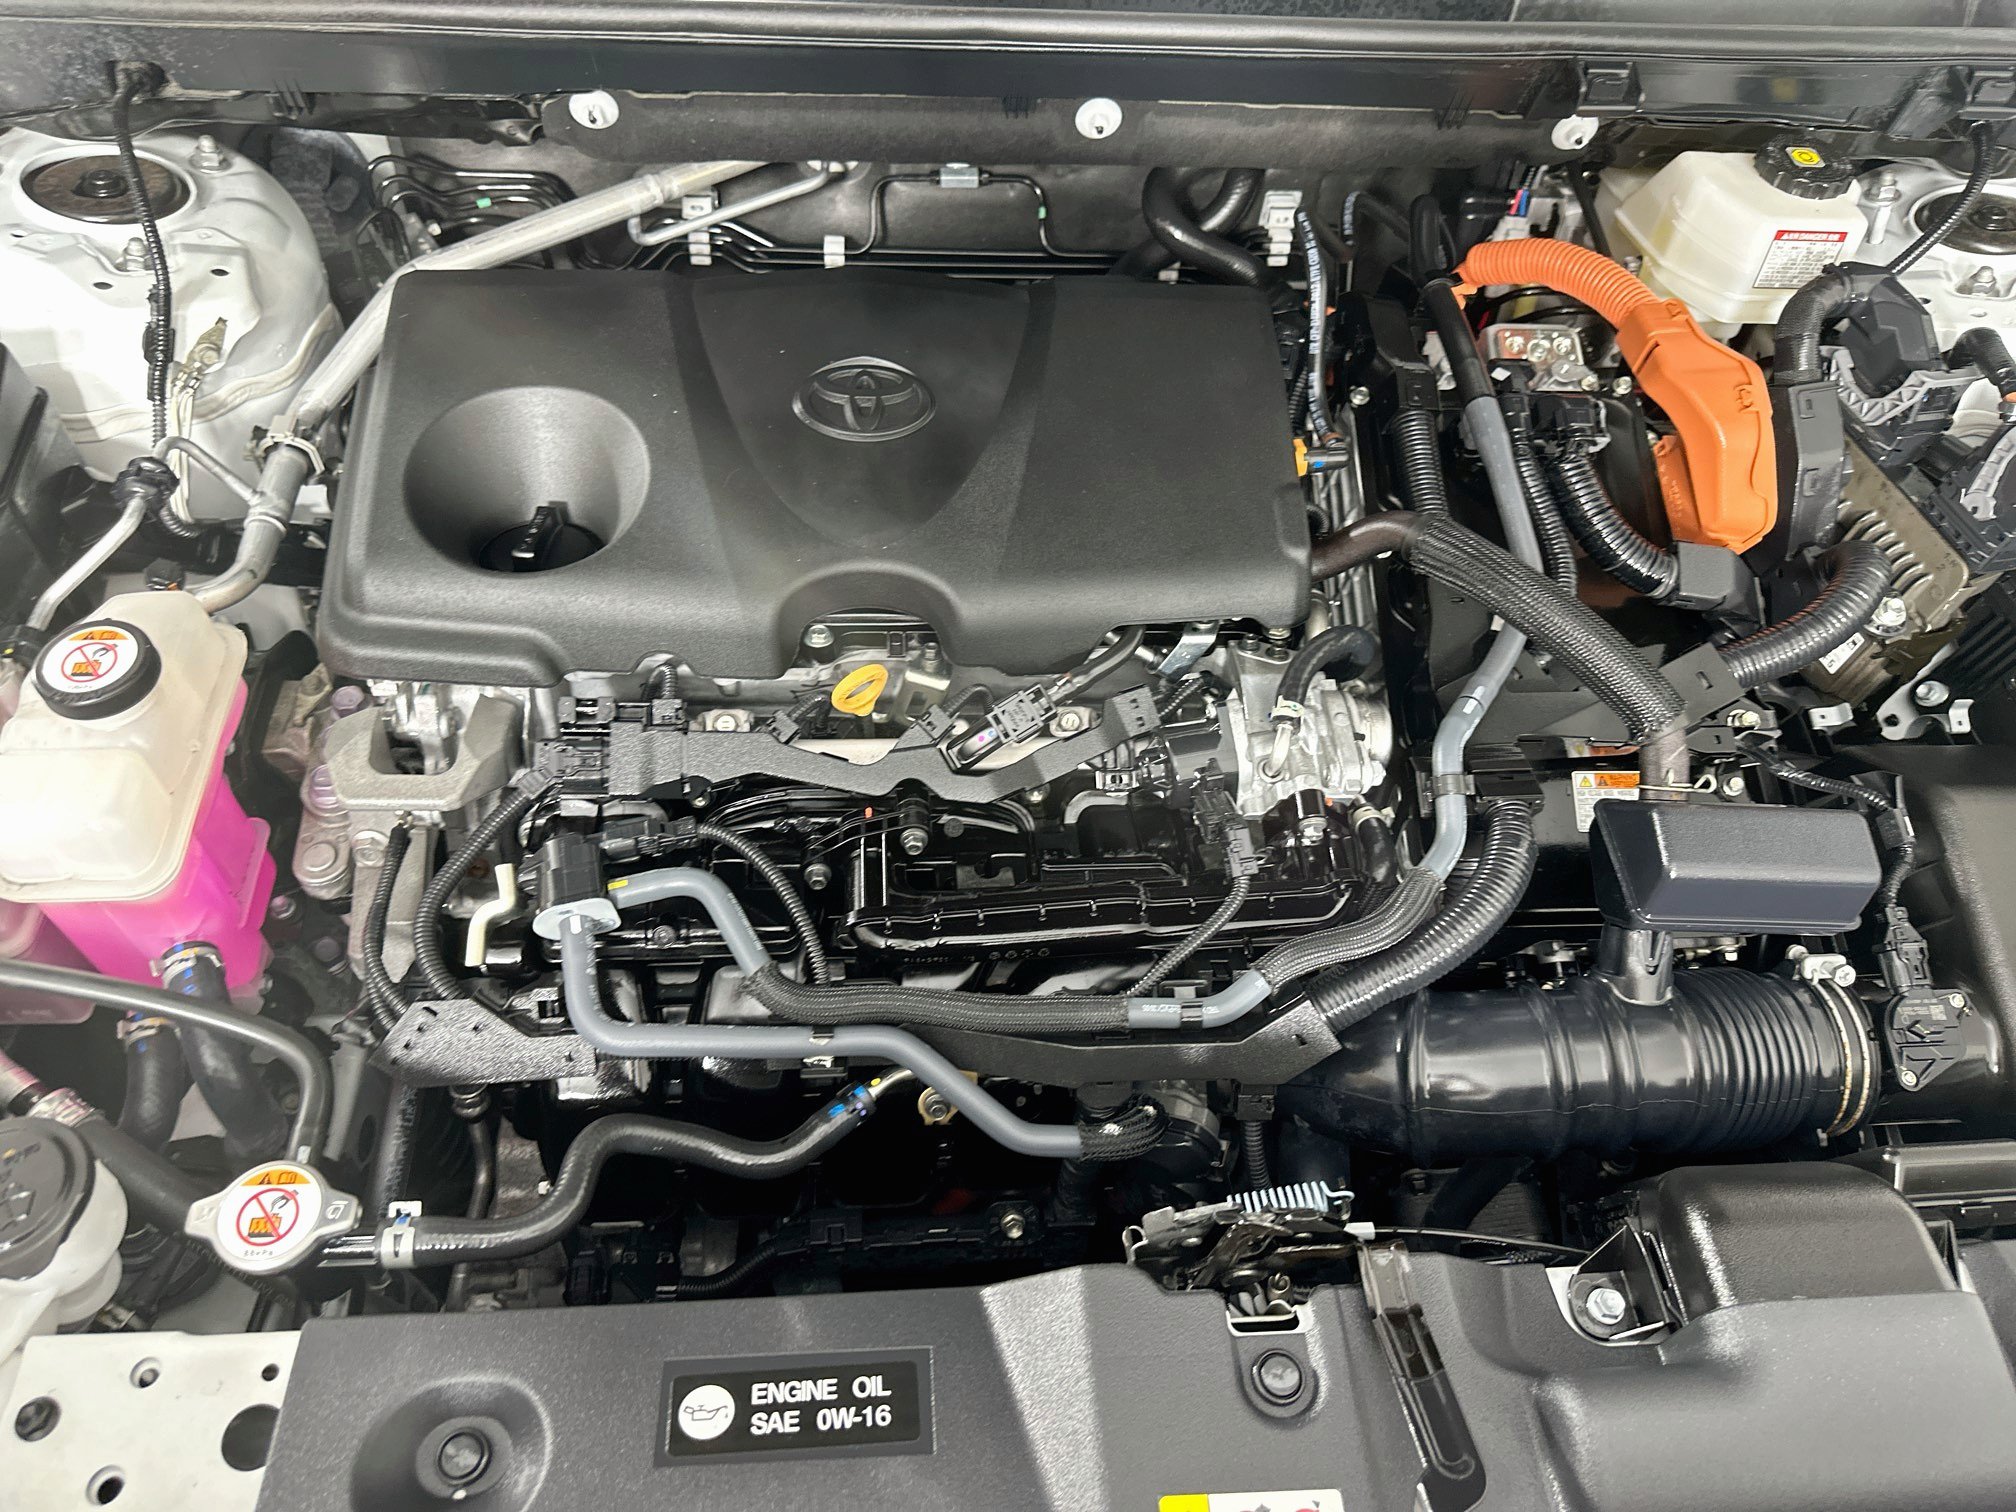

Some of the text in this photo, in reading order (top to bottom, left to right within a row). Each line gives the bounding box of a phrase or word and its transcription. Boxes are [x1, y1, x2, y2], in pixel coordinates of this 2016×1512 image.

[751, 1375, 892, 1405] ENGINE OIL
[750, 1405, 892, 1435] SAE 0W-16
